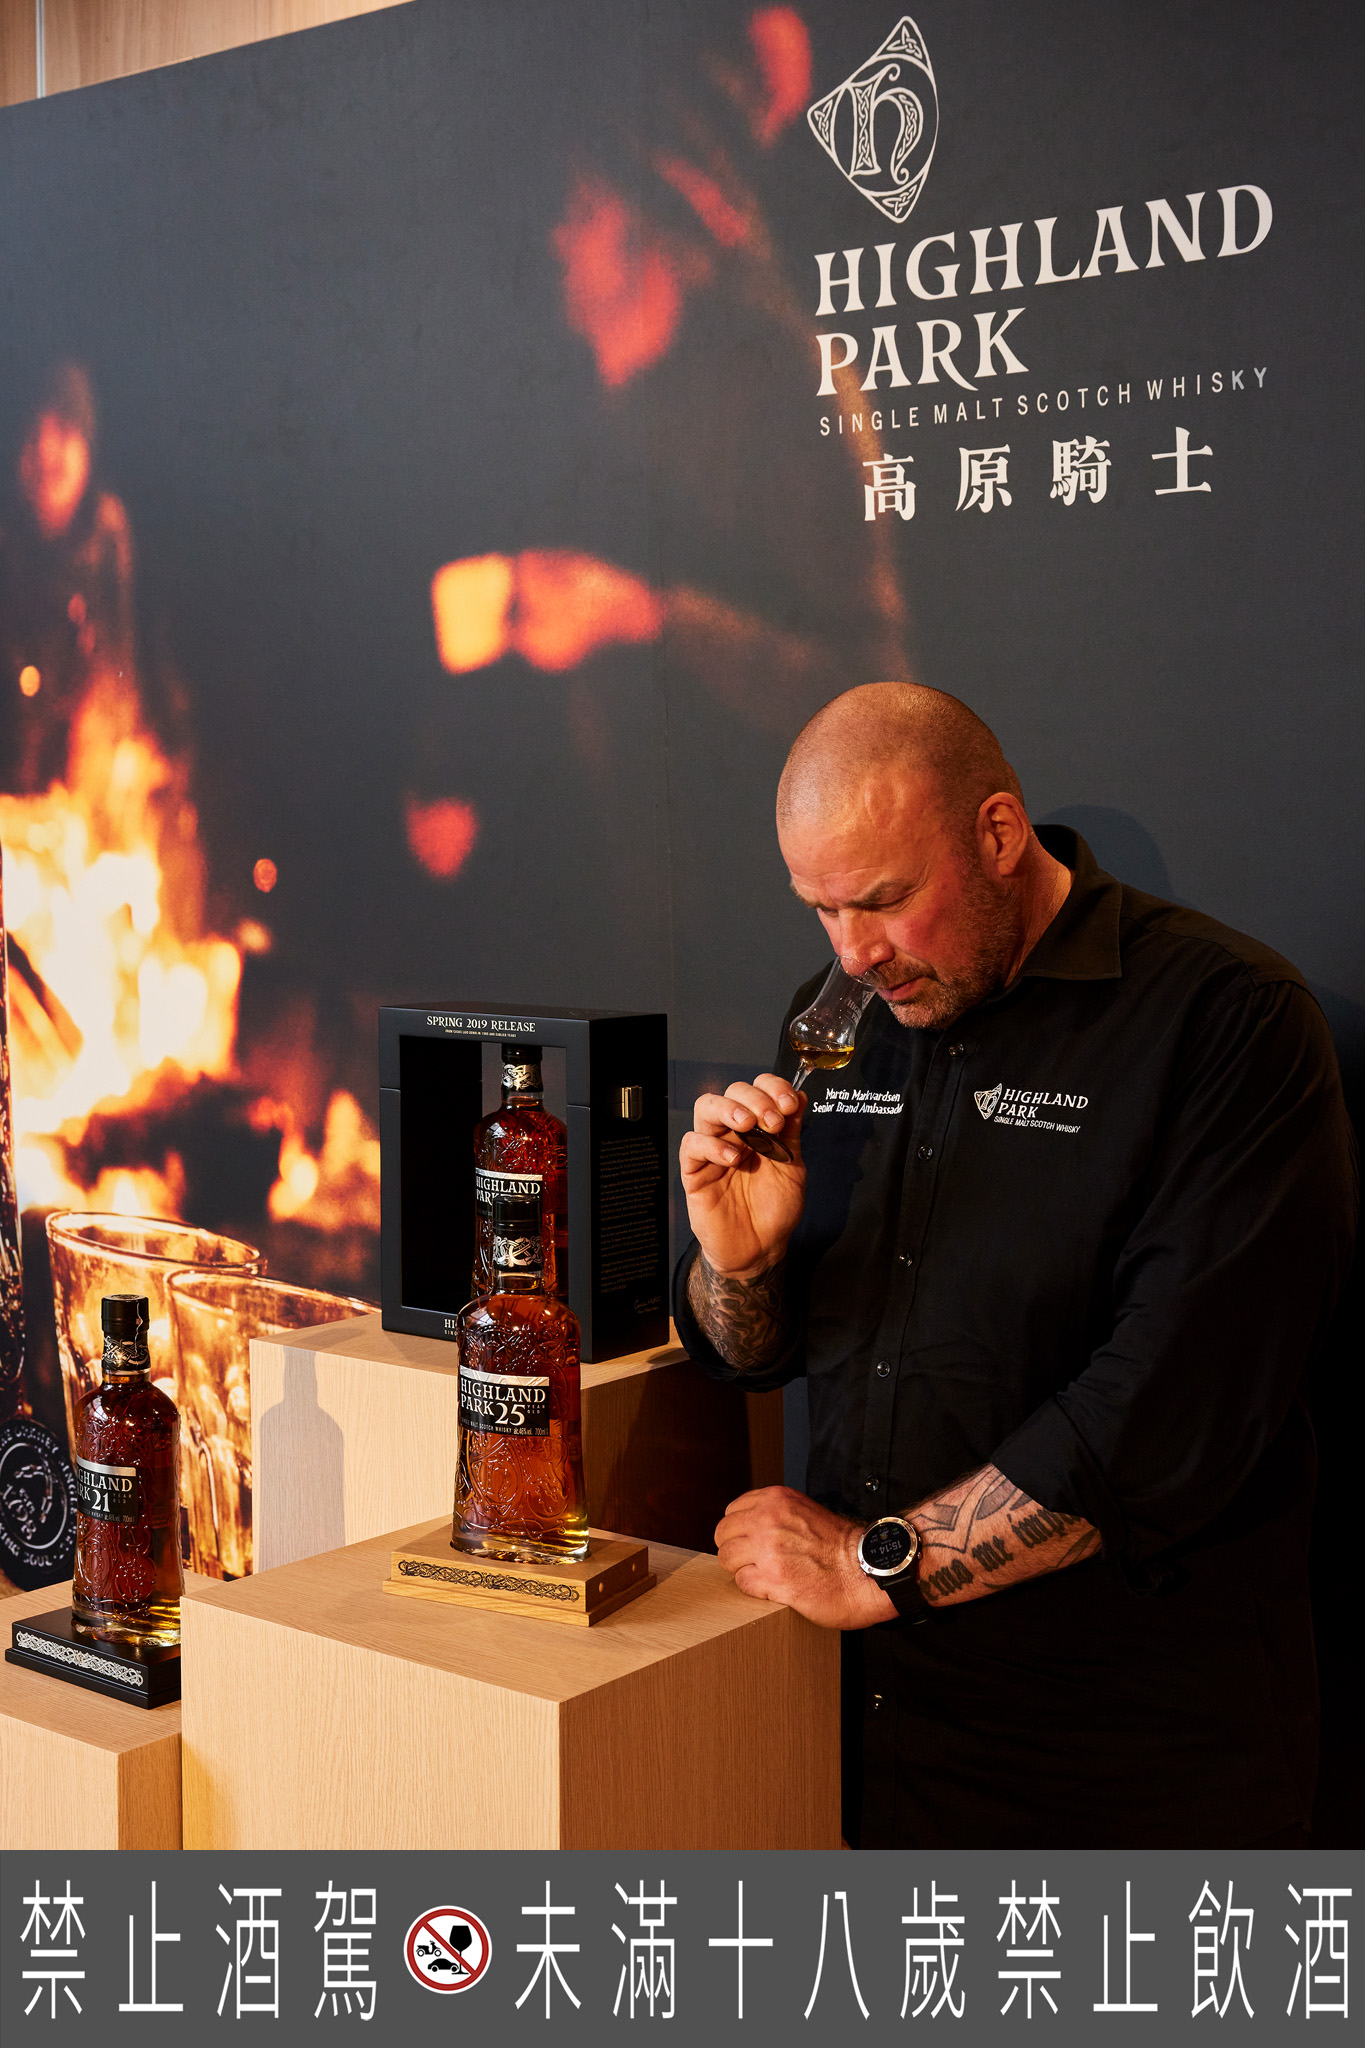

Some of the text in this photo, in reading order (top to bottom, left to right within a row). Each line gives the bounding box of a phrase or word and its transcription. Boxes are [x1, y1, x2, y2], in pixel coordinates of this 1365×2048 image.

[814, 184, 1274, 316] HIGHLAND
[815, 307, 1029, 396] PARK
[819, 367, 1268, 436] SINGLE MALT SCOTCH WHISKY
[862, 427, 1214, 522] 高原騎士
[426, 1015, 536, 1032] SPRING 2019 RELEASE
[825, 1087, 901, 1102] Martin Markvardsen
[1003, 1088, 1089, 1109] HIGHLAND
[812, 1101, 835, 1113] Senior
[836, 1101, 860, 1113] Brand
[997, 1102, 1039, 1119] PARK
[993, 1115, 1081, 1133] SINGLE MALT SCOTCH WHISKY
[476, 1175, 541, 1194] HIGHLAND
[460, 1377, 546, 1403] HIGHLAND
[460, 1393, 494, 1417] PARK
[494, 1402, 527, 1426] 25
[78, 1468, 133, 1492] GHLAND
[91, 1489, 110, 1513] 21
[879, 1540, 902, 1555] 15:14
